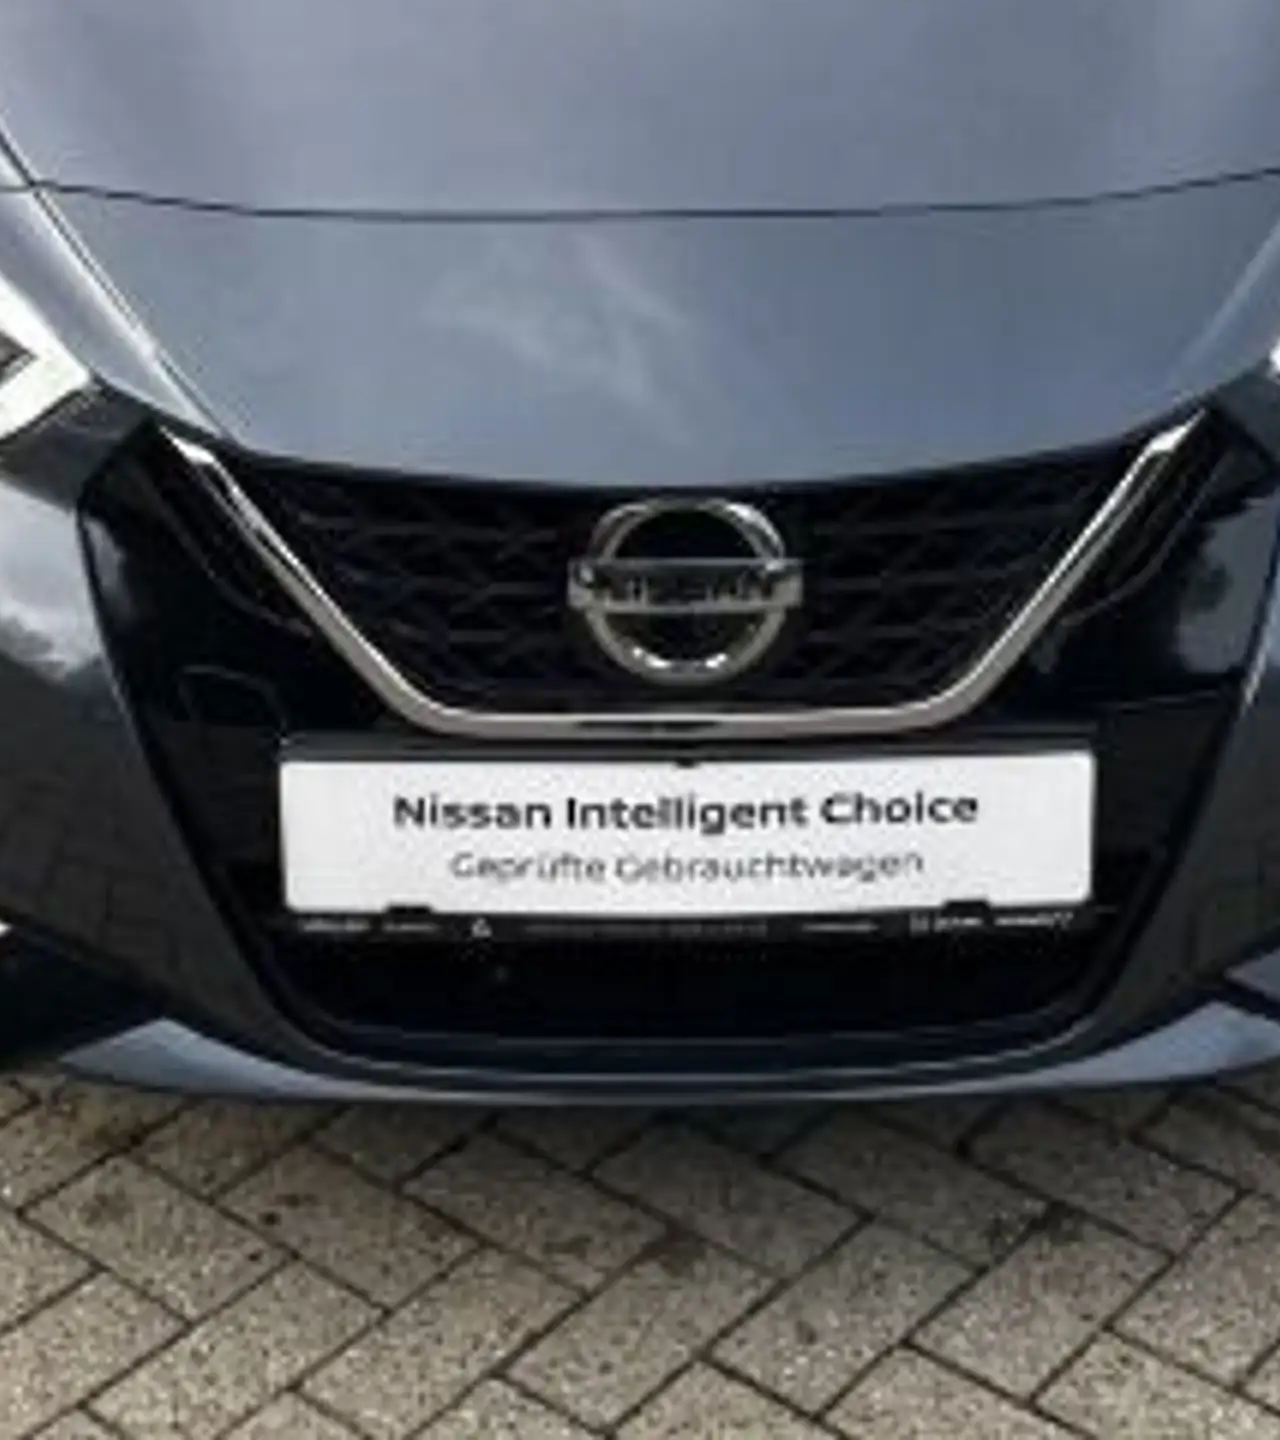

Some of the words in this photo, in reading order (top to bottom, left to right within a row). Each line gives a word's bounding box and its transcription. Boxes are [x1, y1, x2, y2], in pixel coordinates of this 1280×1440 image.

[392, 794, 552, 831] Nissan
[567, 792, 808, 836] Intelligent
[821, 789, 979, 826] Choice
[451, 851, 606, 887] Geprüfte
[616, 849, 926, 886] Gebrauchtwagen
